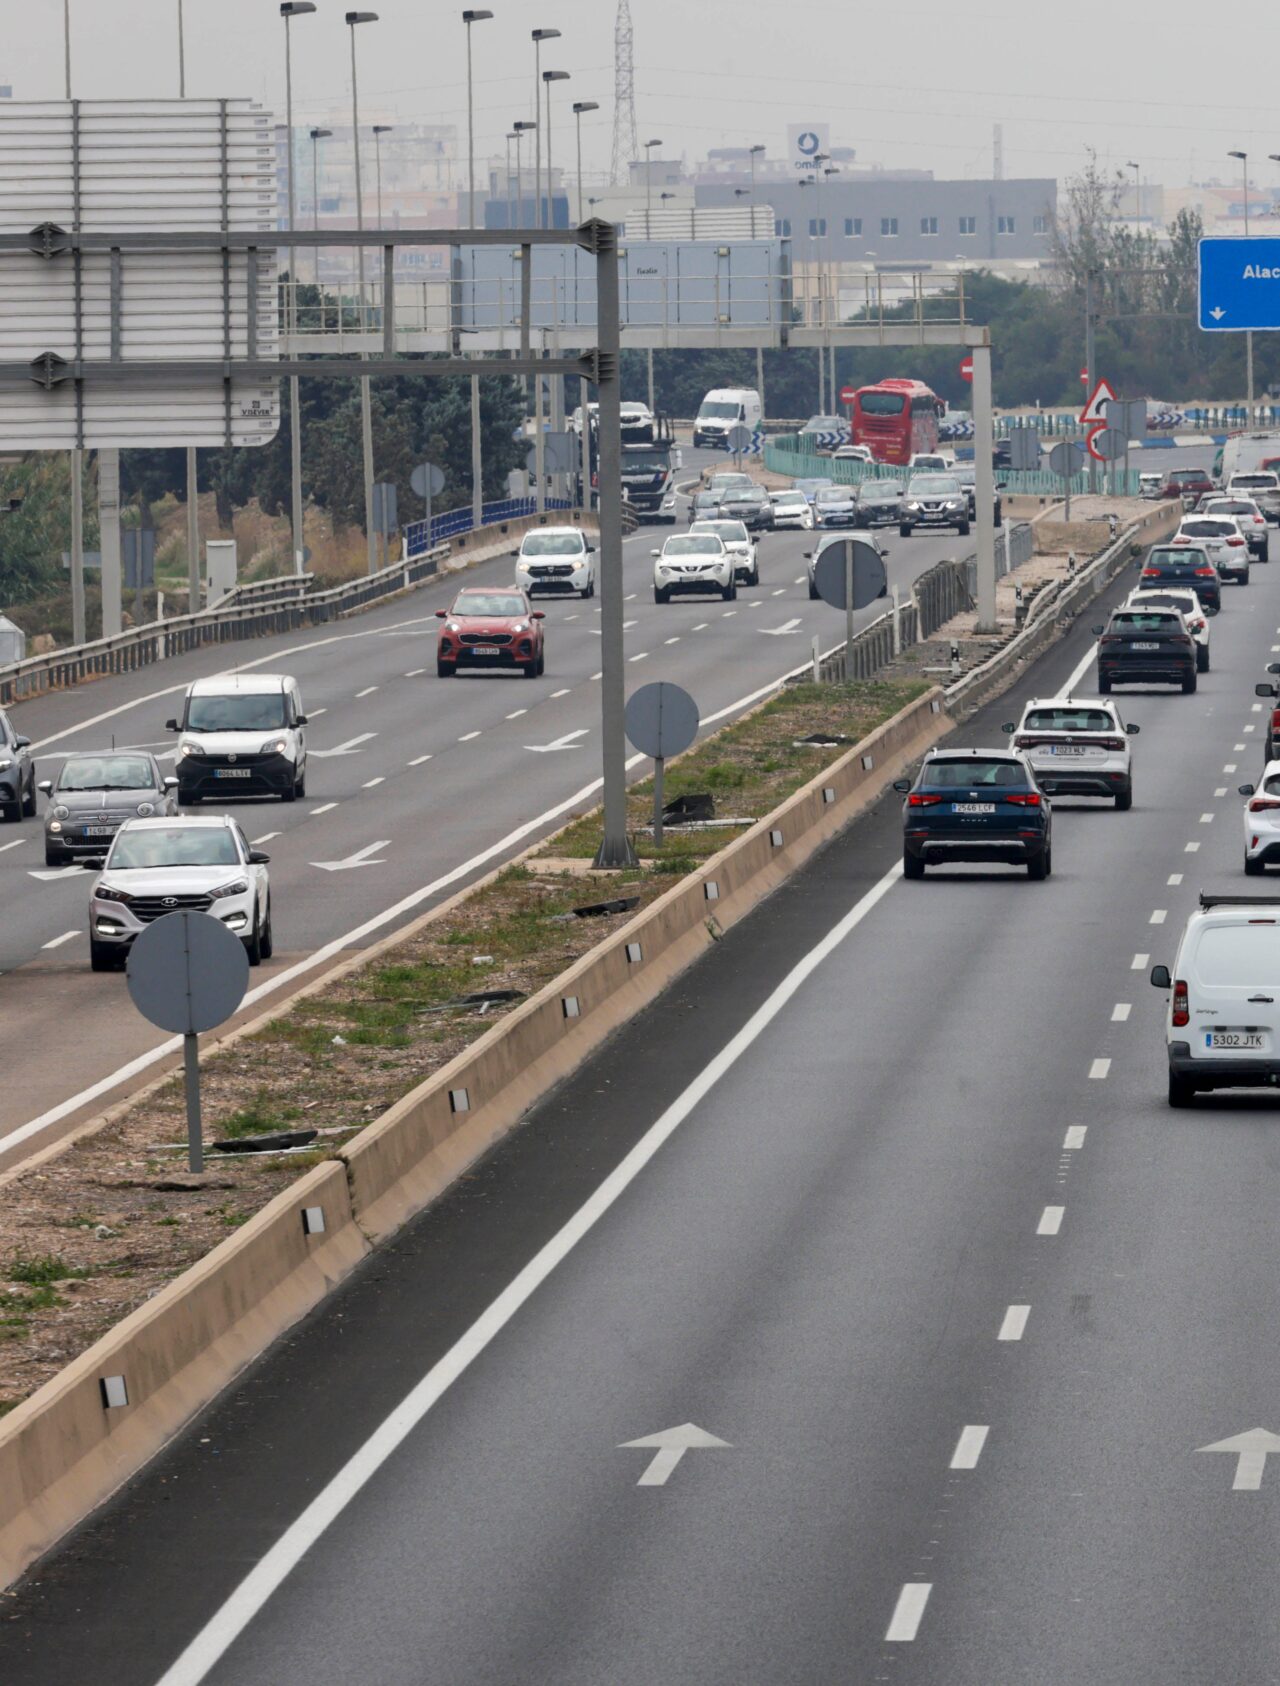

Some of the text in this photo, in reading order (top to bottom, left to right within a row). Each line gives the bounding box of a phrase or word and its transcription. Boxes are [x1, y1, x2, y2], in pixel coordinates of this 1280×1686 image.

[957, 804, 977, 812] 2546
[1213, 1035, 1262, 1045] 5302 JTK
